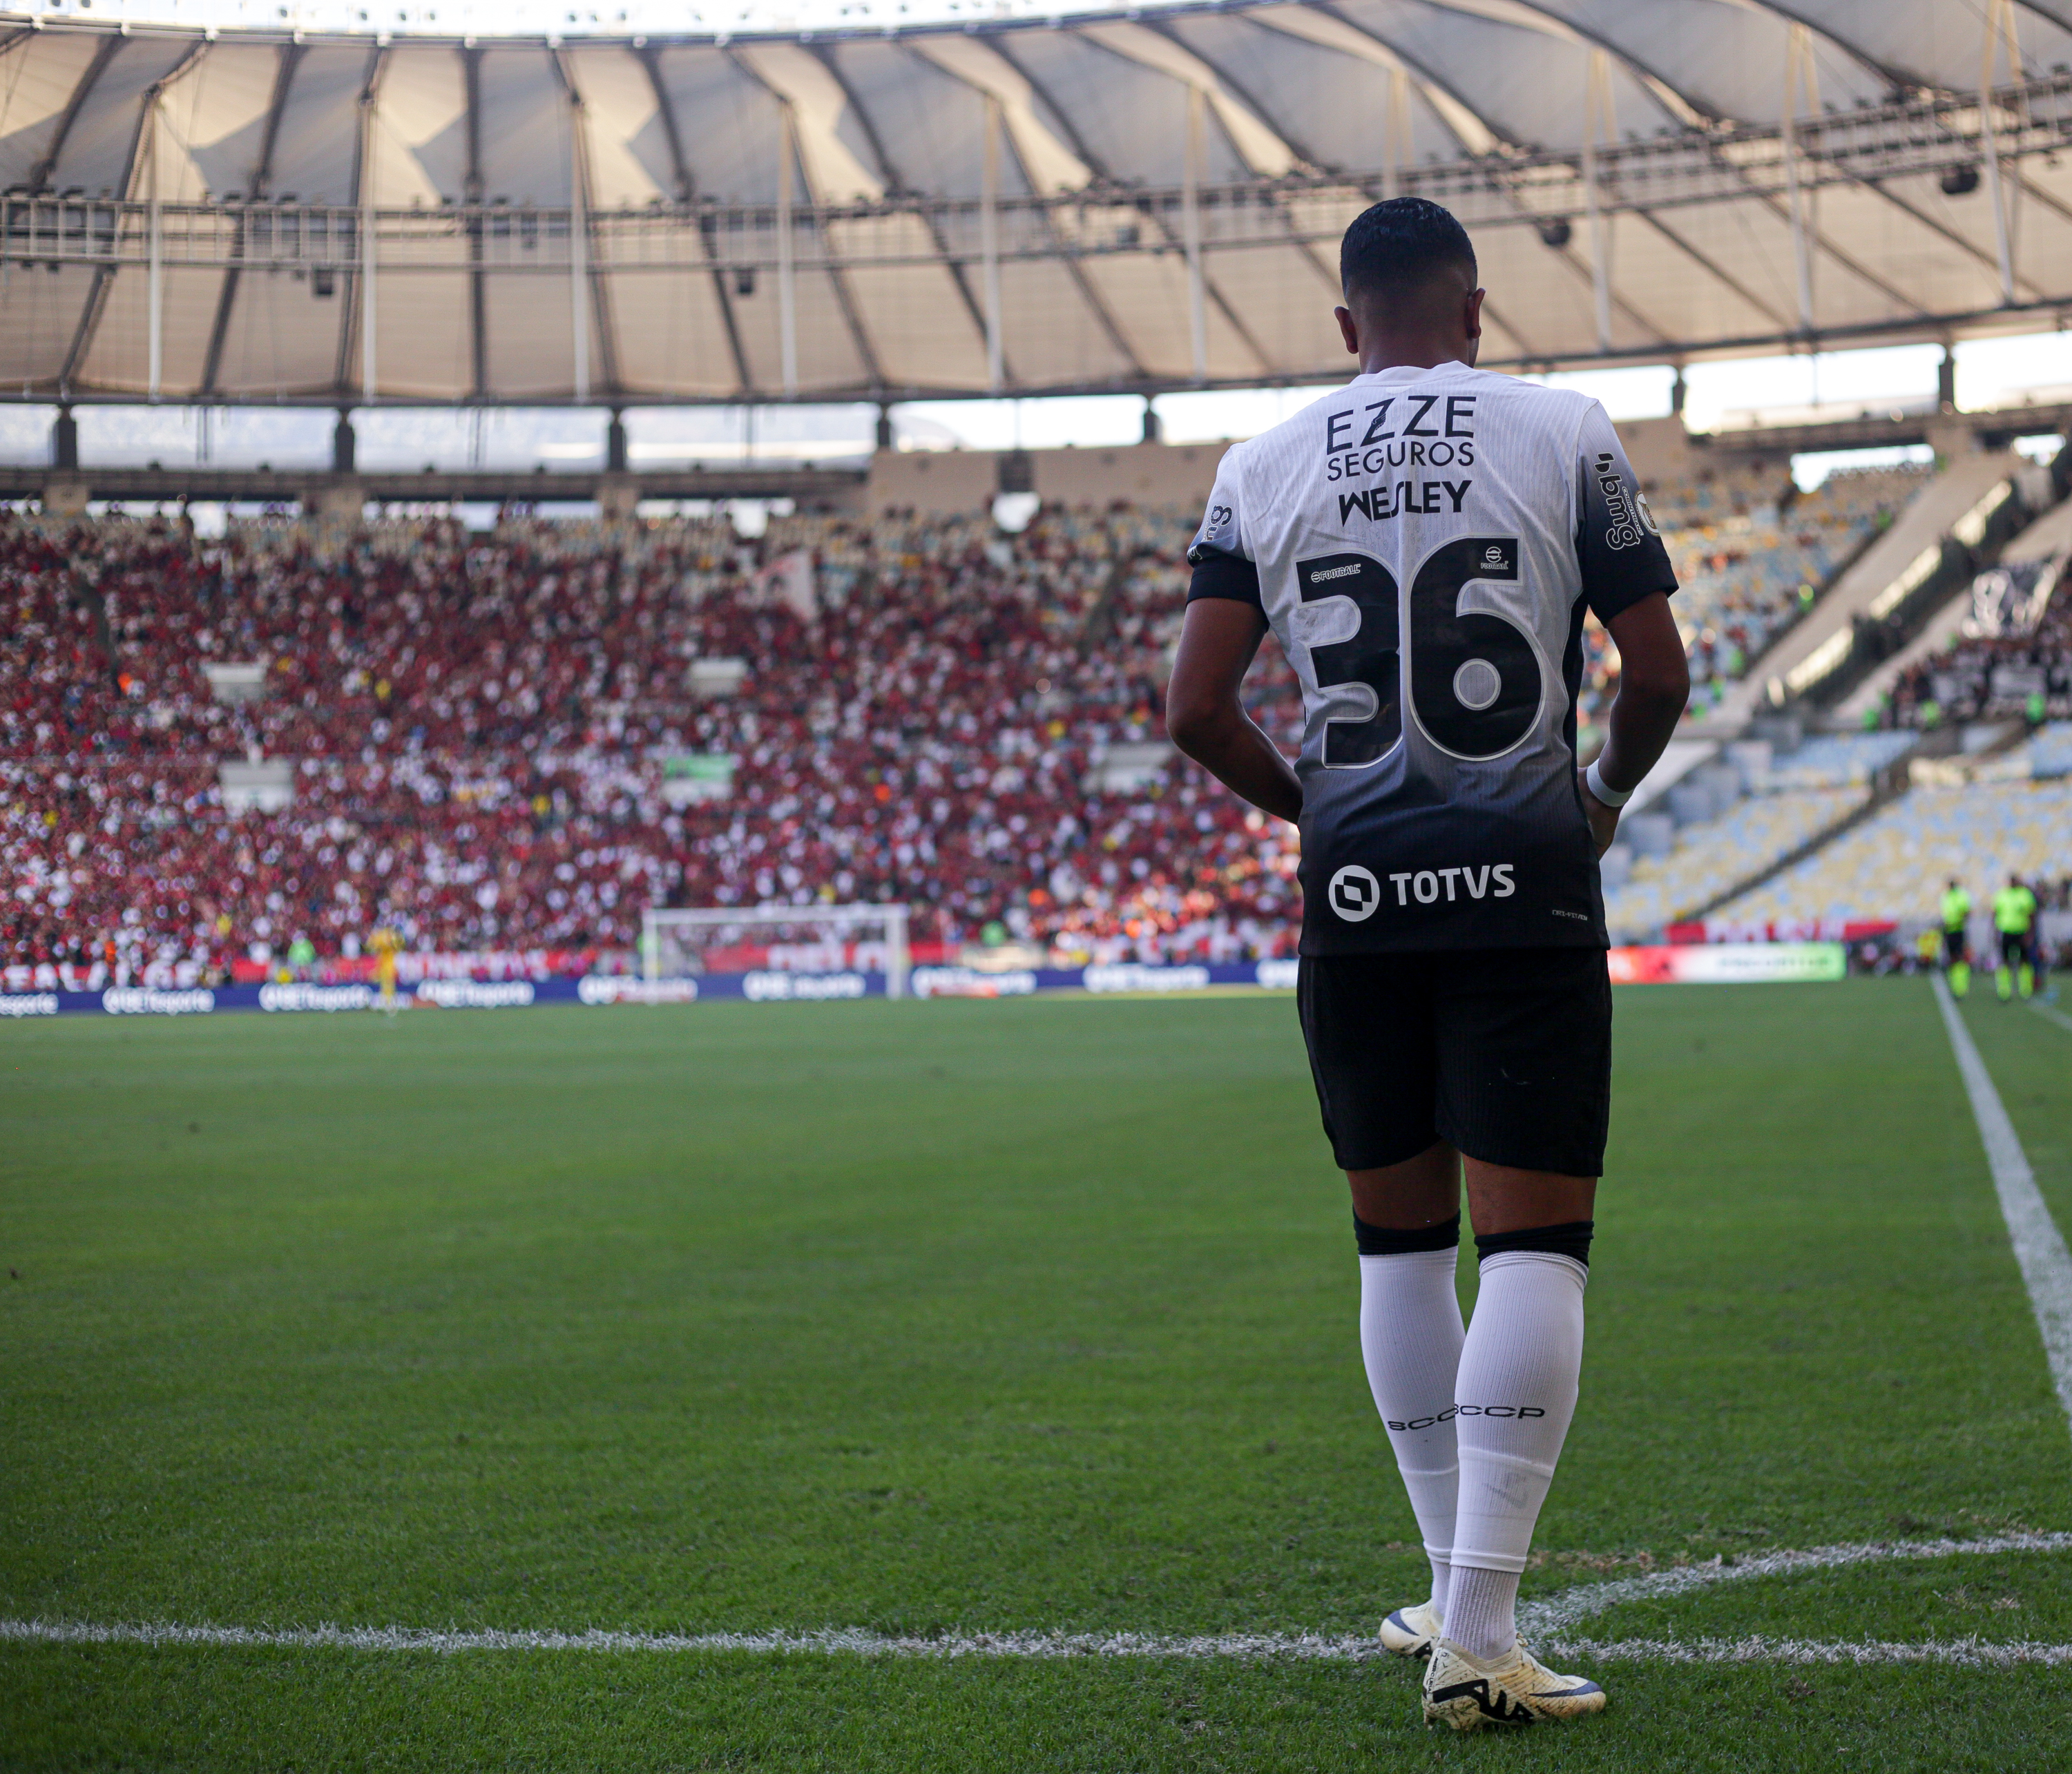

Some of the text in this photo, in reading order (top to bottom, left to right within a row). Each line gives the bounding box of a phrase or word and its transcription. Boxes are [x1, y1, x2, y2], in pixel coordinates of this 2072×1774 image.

[1327, 395, 1477, 456] EZZE
[1327, 441, 1475, 481] SEGUROS
[1339, 480, 1473, 528] WESLEY
[1598, 474, 1640, 550] bmg
[1622, 486, 1644, 536] CORINTHIANS
[1292, 532, 1546, 769] 36
[1390, 864, 1515, 906] TOTVS
[1388, 1407, 1456, 1431] SCC
